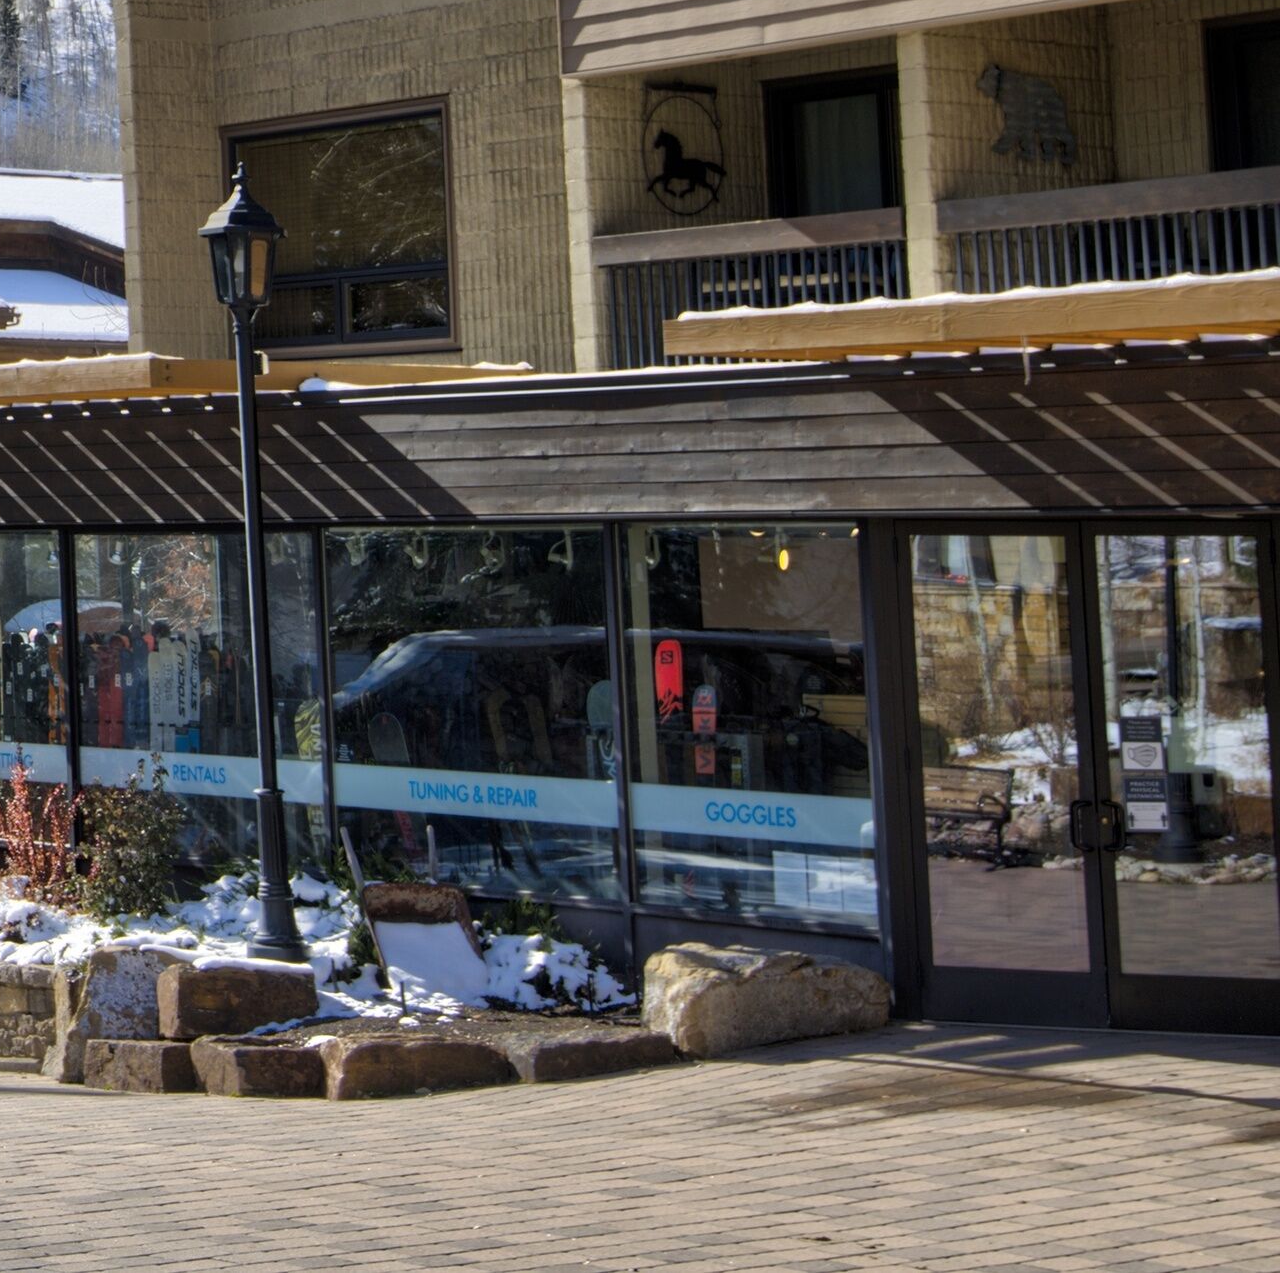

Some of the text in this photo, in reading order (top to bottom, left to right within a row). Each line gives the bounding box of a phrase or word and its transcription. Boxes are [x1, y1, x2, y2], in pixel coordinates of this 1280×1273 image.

[172, 764, 226, 784] RENTALS
[408, 780, 537, 808] TUNING & REPAIR
[705, 801, 796, 828] GOGGLES
